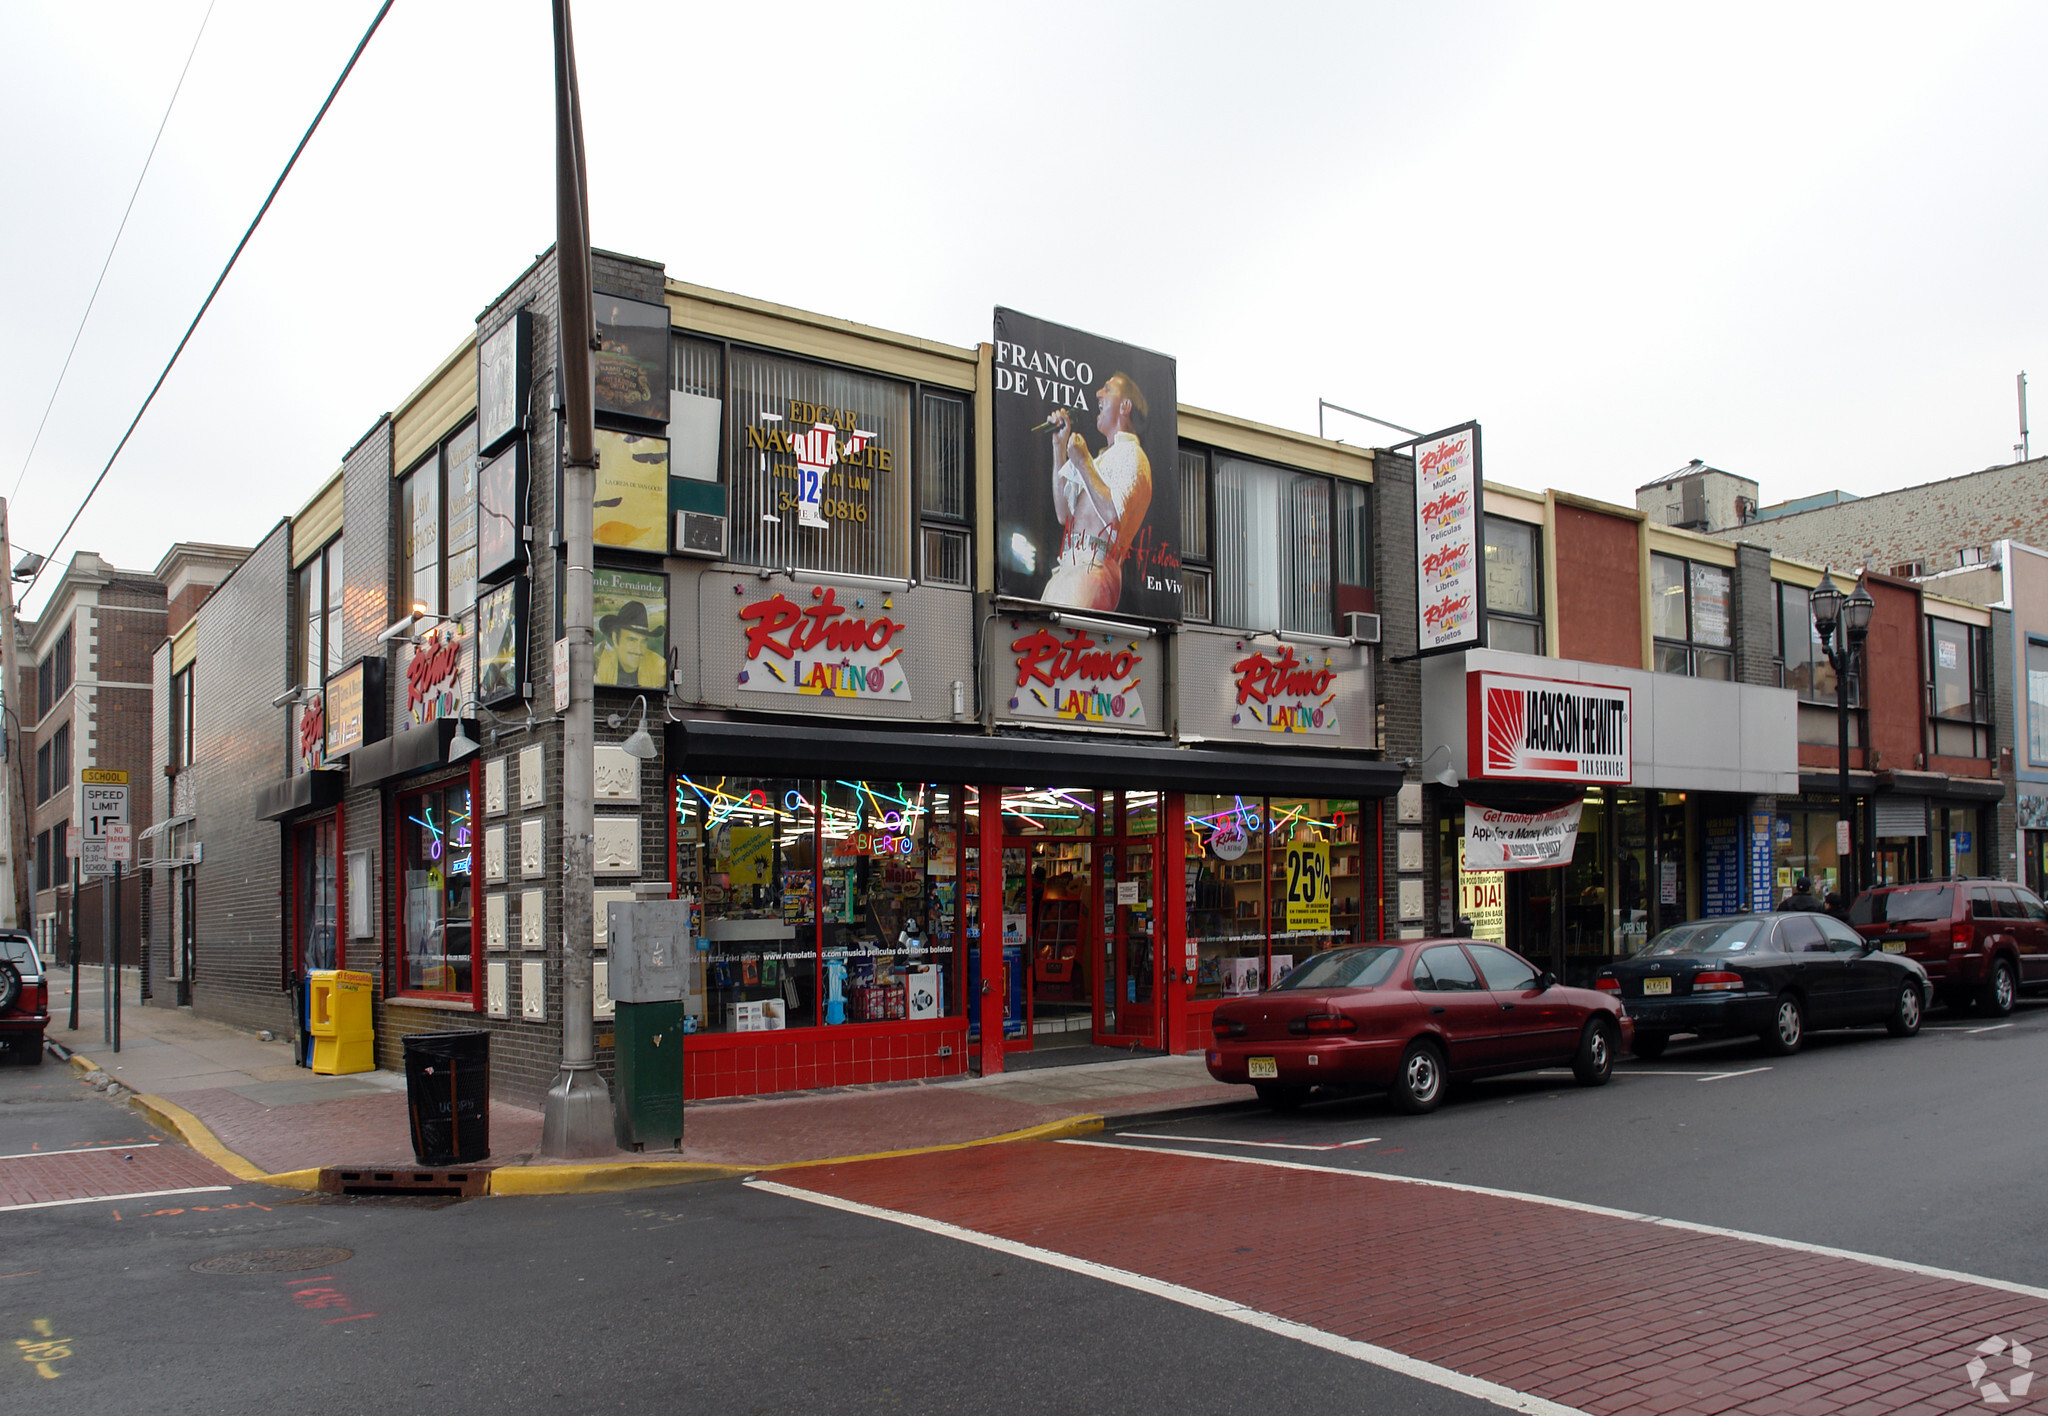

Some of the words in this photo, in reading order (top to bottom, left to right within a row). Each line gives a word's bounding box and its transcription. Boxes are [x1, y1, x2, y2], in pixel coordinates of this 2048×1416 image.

[996, 340, 1093, 385] FRANCO
[996, 367, 1030, 396] DE
[1034, 377, 1090, 411] VITA
[790, 400, 857, 431] EDGAR
[1420, 438, 1467, 474] Ritmo
[831, 474, 844, 487] AT
[849, 477, 870, 490] LAW
[778, 491, 868, 522] 34-0816
[1421, 490, 1468, 524] Ritmo
[1422, 542, 1470, 576] Ritmo
[612, 574, 662, 592] Fernández
[1147, 575, 1162, 591] En
[1435, 578, 1460, 593] Libros
[1423, 595, 1471, 627] Ritmo
[738, 586, 905, 660] Ritmo
[1435, 629, 1462, 644] Boletos
[1012, 626, 1143, 688] Ritmo
[407, 629, 460, 711] Ritmo
[1231, 646, 1337, 704] Ritmo
[1525, 690, 1580, 754] JACKSON
[1582, 697, 1624, 756] HEWITT
[88, 772, 121, 782] SCHOOL
[1582, 759, 1595, 775] TAX
[1595, 760, 1624, 777] SERVICE
[88, 790, 123, 799] SPEED
[92, 802, 119, 810] LIMIT
[1483, 810, 1502, 822] Get
[1503, 813, 1536, 826] money
[1535, 811, 1545, 822] in
[1508, 831, 1513, 839] a
[1514, 828, 1542, 842] Money
[1542, 825, 1561, 838] Now
[844, 833, 913, 855] ABIERTO
[1510, 843, 1537, 857] JACKSON
[1287, 850, 1330, 903] 25%
[1477, 876, 1491, 884] TIEMPO
[1492, 875, 1503, 883] COMO
[1462, 886, 1468, 909] 1
[1474, 884, 1502, 908] DIA!
[1623, 922, 1636, 933] OPEN
[842, 948, 866, 956] musica
[897, 947, 909, 955] dvd
[910, 946, 929, 954] libros
[929, 945, 953, 953] boletos
[337, 971, 343, 979] El
